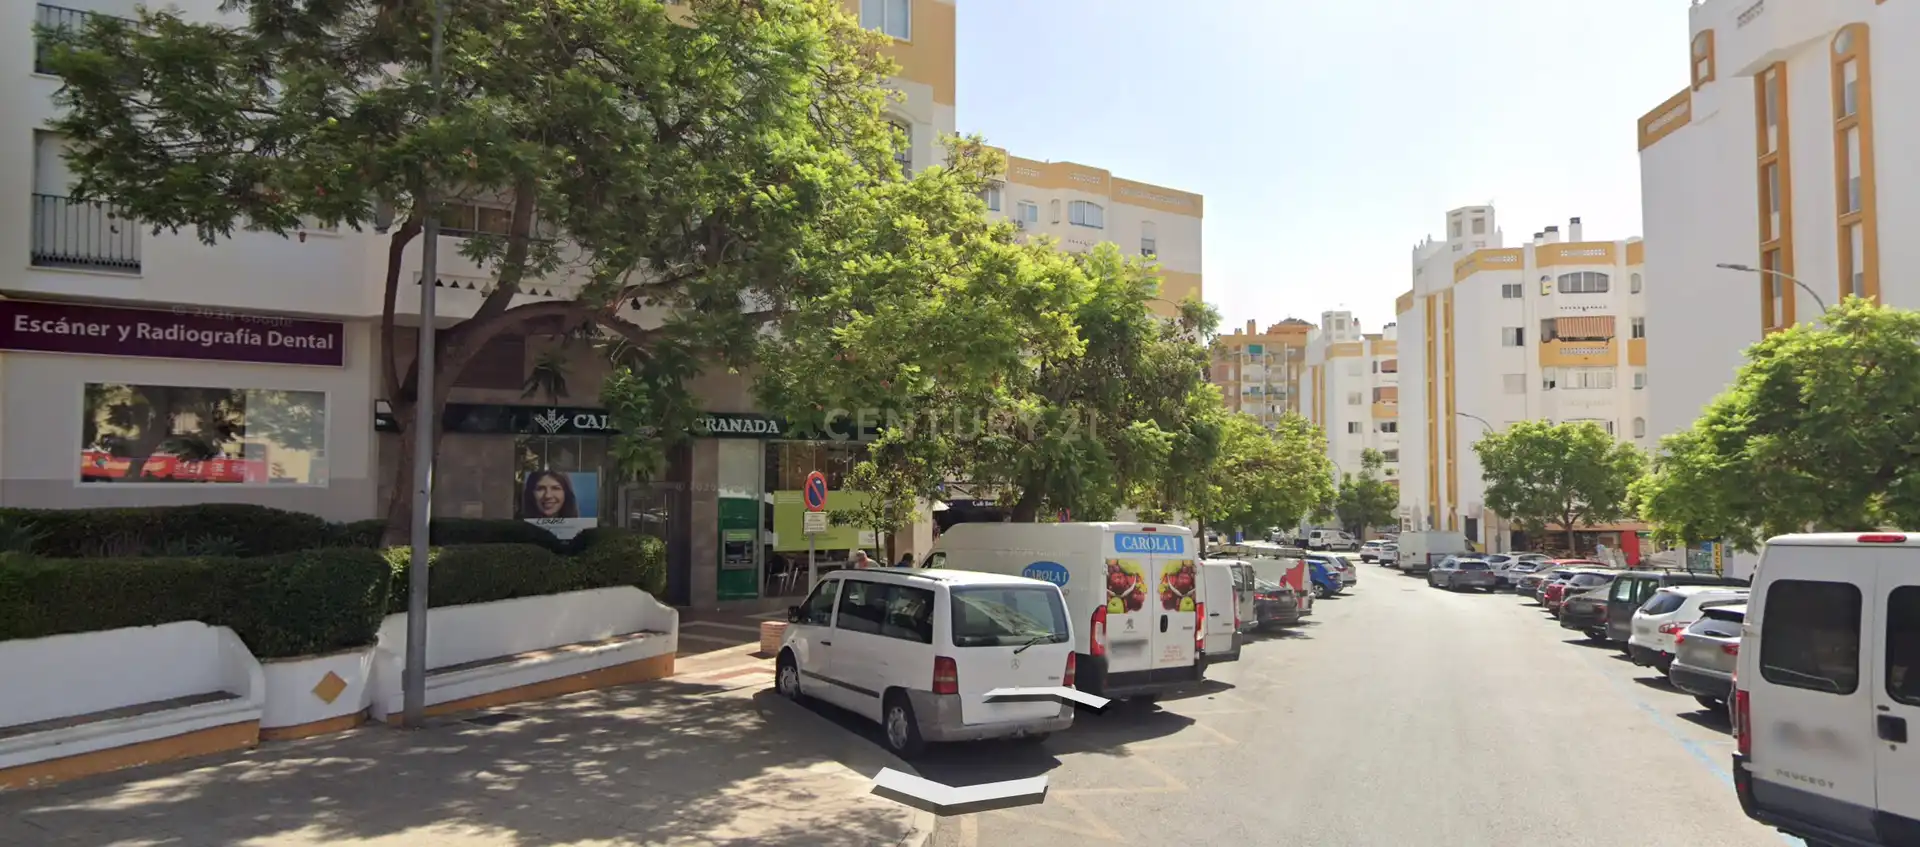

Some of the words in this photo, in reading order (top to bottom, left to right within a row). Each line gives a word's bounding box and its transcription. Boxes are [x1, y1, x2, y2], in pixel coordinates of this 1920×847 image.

[14, 314, 110, 336] Escáner
[117, 325, 130, 341] y
[136, 322, 262, 347] Radiografía
[267, 331, 333, 350] Dental
[573, 414, 612, 429] CAJ
[1121, 536, 1172, 551] CAROLA
[1024, 568, 1060, 582] CAROLA
[1775, 768, 1835, 789] PEUGEOT
